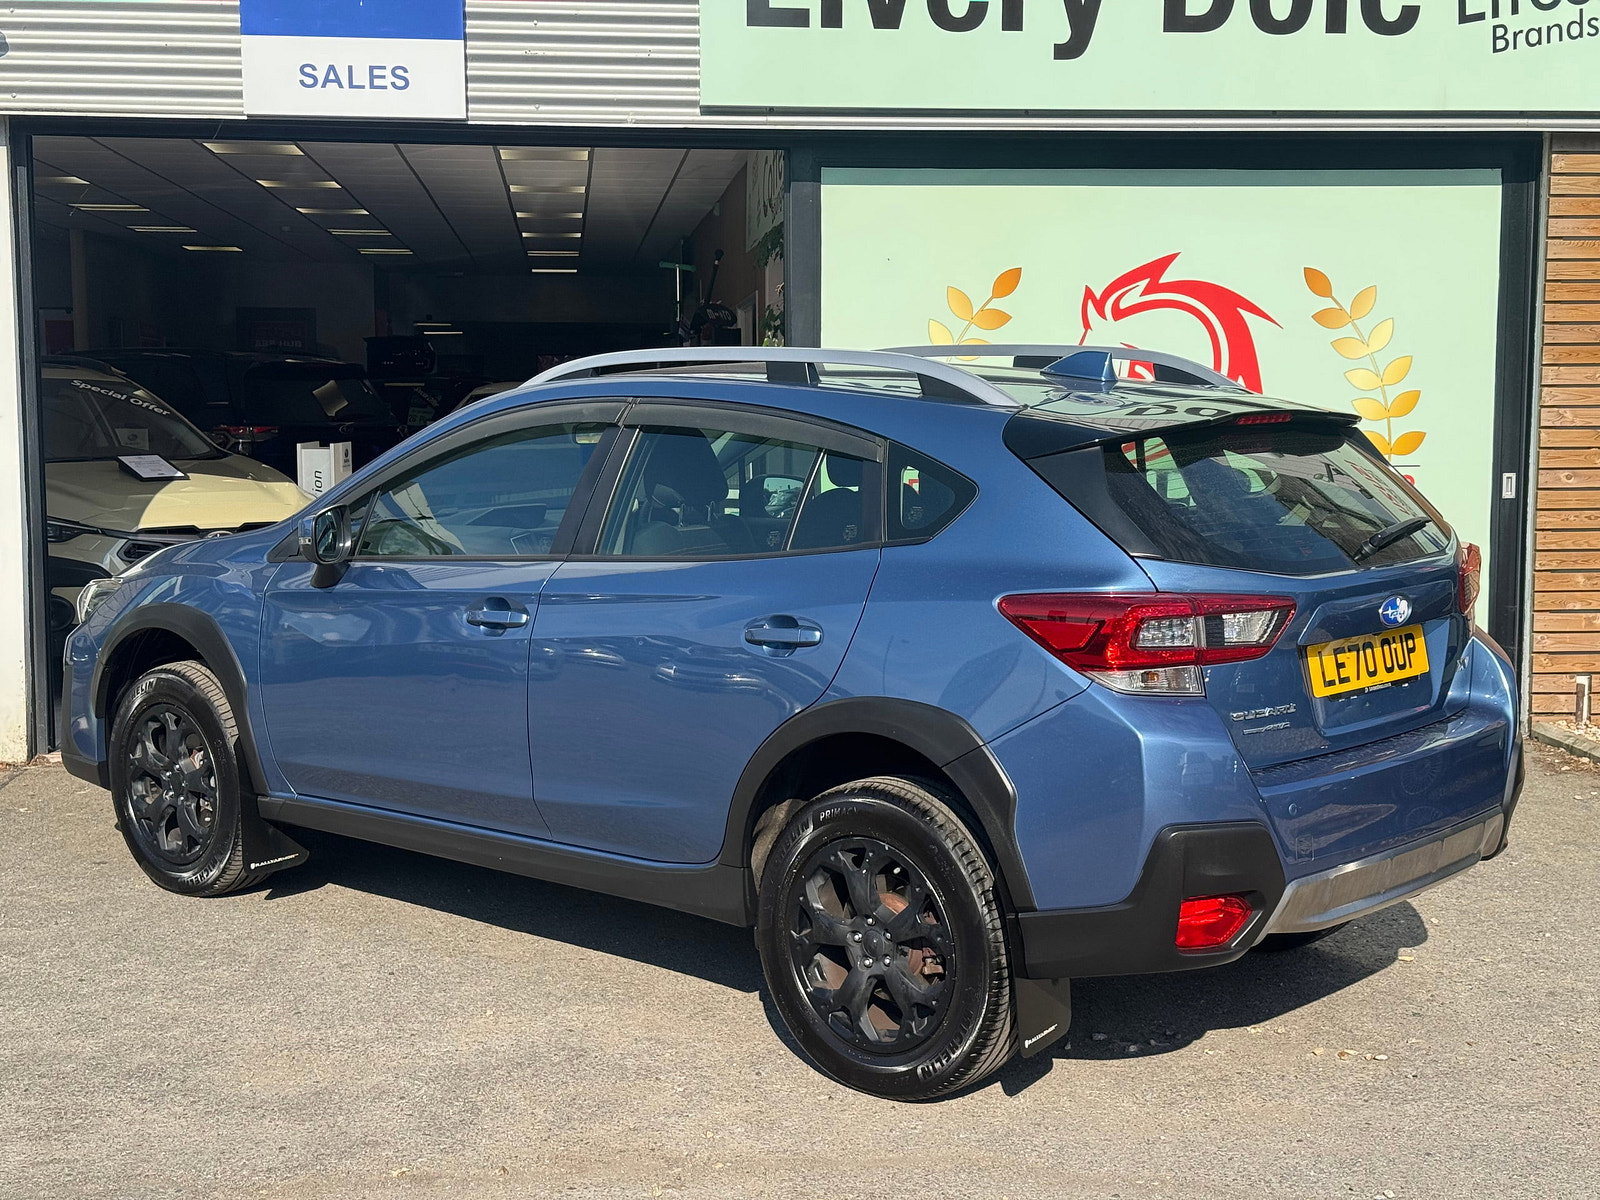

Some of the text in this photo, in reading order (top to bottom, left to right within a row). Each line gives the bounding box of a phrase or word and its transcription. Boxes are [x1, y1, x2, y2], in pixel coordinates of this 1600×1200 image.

[1492, 8, 1600, 53] Brands
[299, 63, 410, 91] SALES
[70, 380, 171, 416] Special Offer
[311, 469, 324, 494] ion
[1318, 641, 1378, 688] LE70
